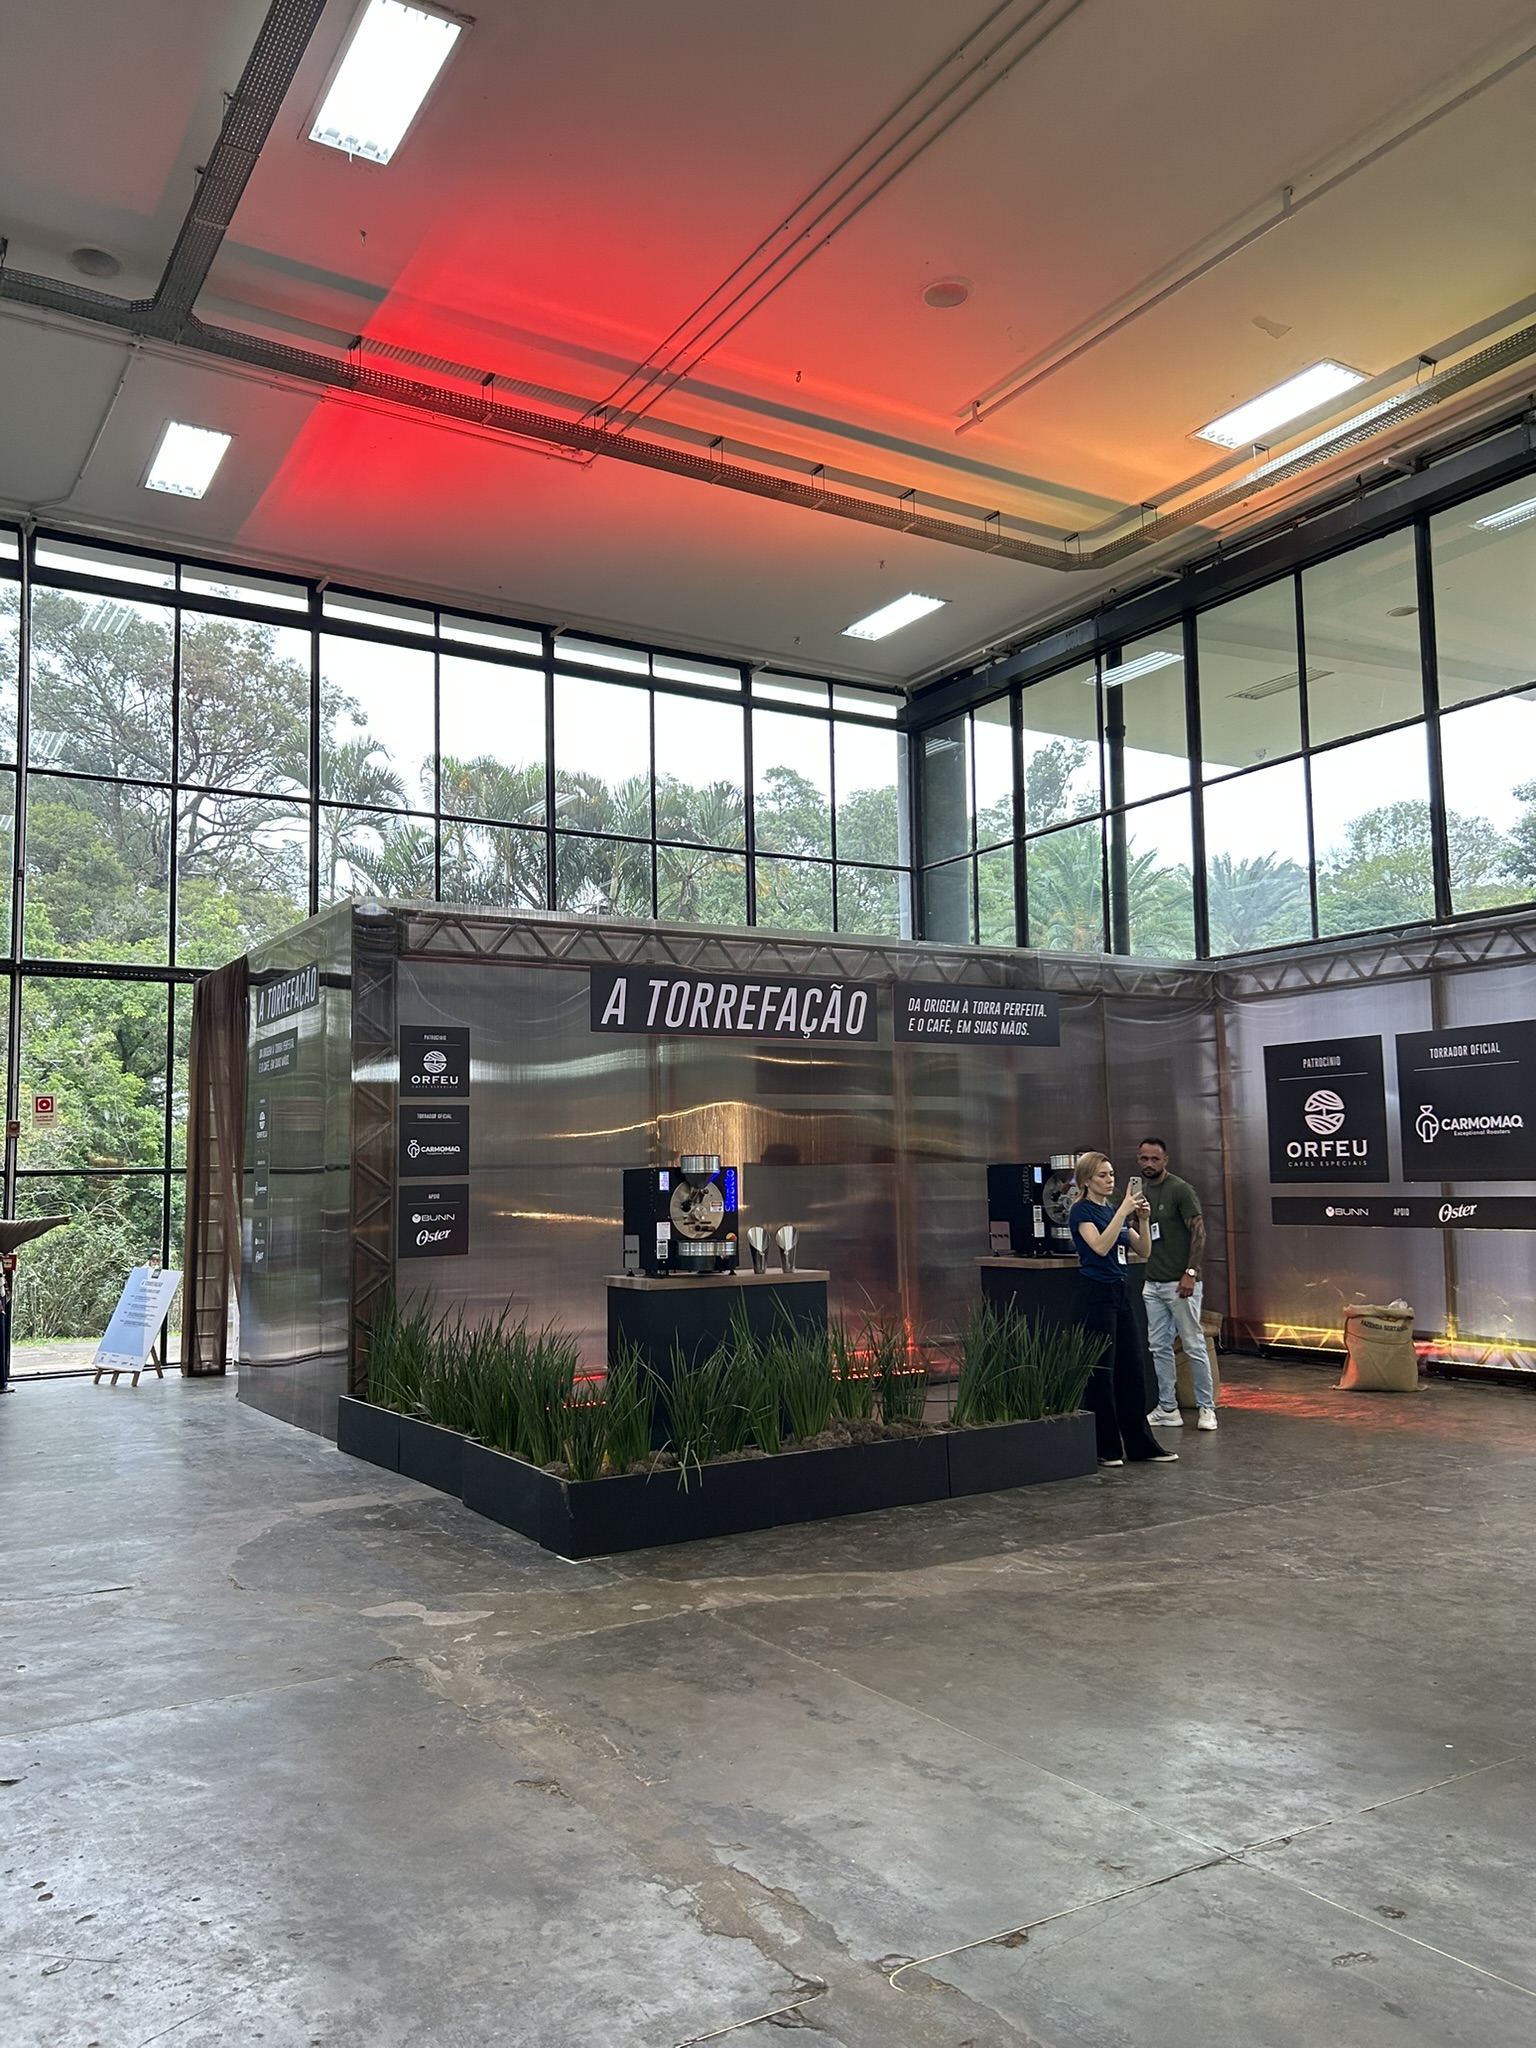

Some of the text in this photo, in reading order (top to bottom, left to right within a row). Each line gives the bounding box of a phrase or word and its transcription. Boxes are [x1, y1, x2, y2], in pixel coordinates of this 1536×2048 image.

[258, 966, 317, 1023] A TORREFAÇÃO
[601, 977, 868, 1038] A TORREFAÇÃO
[908, 997, 1047, 1017] DA ORIGEM À TORRA PERFEITA.
[908, 1017, 1030, 1036] E O CAFÉ, EM SUAS MÃOS.
[1429, 1042, 1501, 1059] TORRADOR OFICIAL
[1302, 1055, 1341, 1068] PATROCÍNIO
[411, 1075, 459, 1085] ORFEU
[1441, 1114, 1523, 1130] CARMOMAQ
[1286, 1139, 1368, 1158] ORFEU
[421, 1213, 456, 1222] BUNN
[1335, 1207, 1369, 1216] BUNN
[1393, 1207, 1410, 1217] APOIO
[1438, 1203, 1478, 1223] Oster
[416, 1228, 452, 1246] Oster
